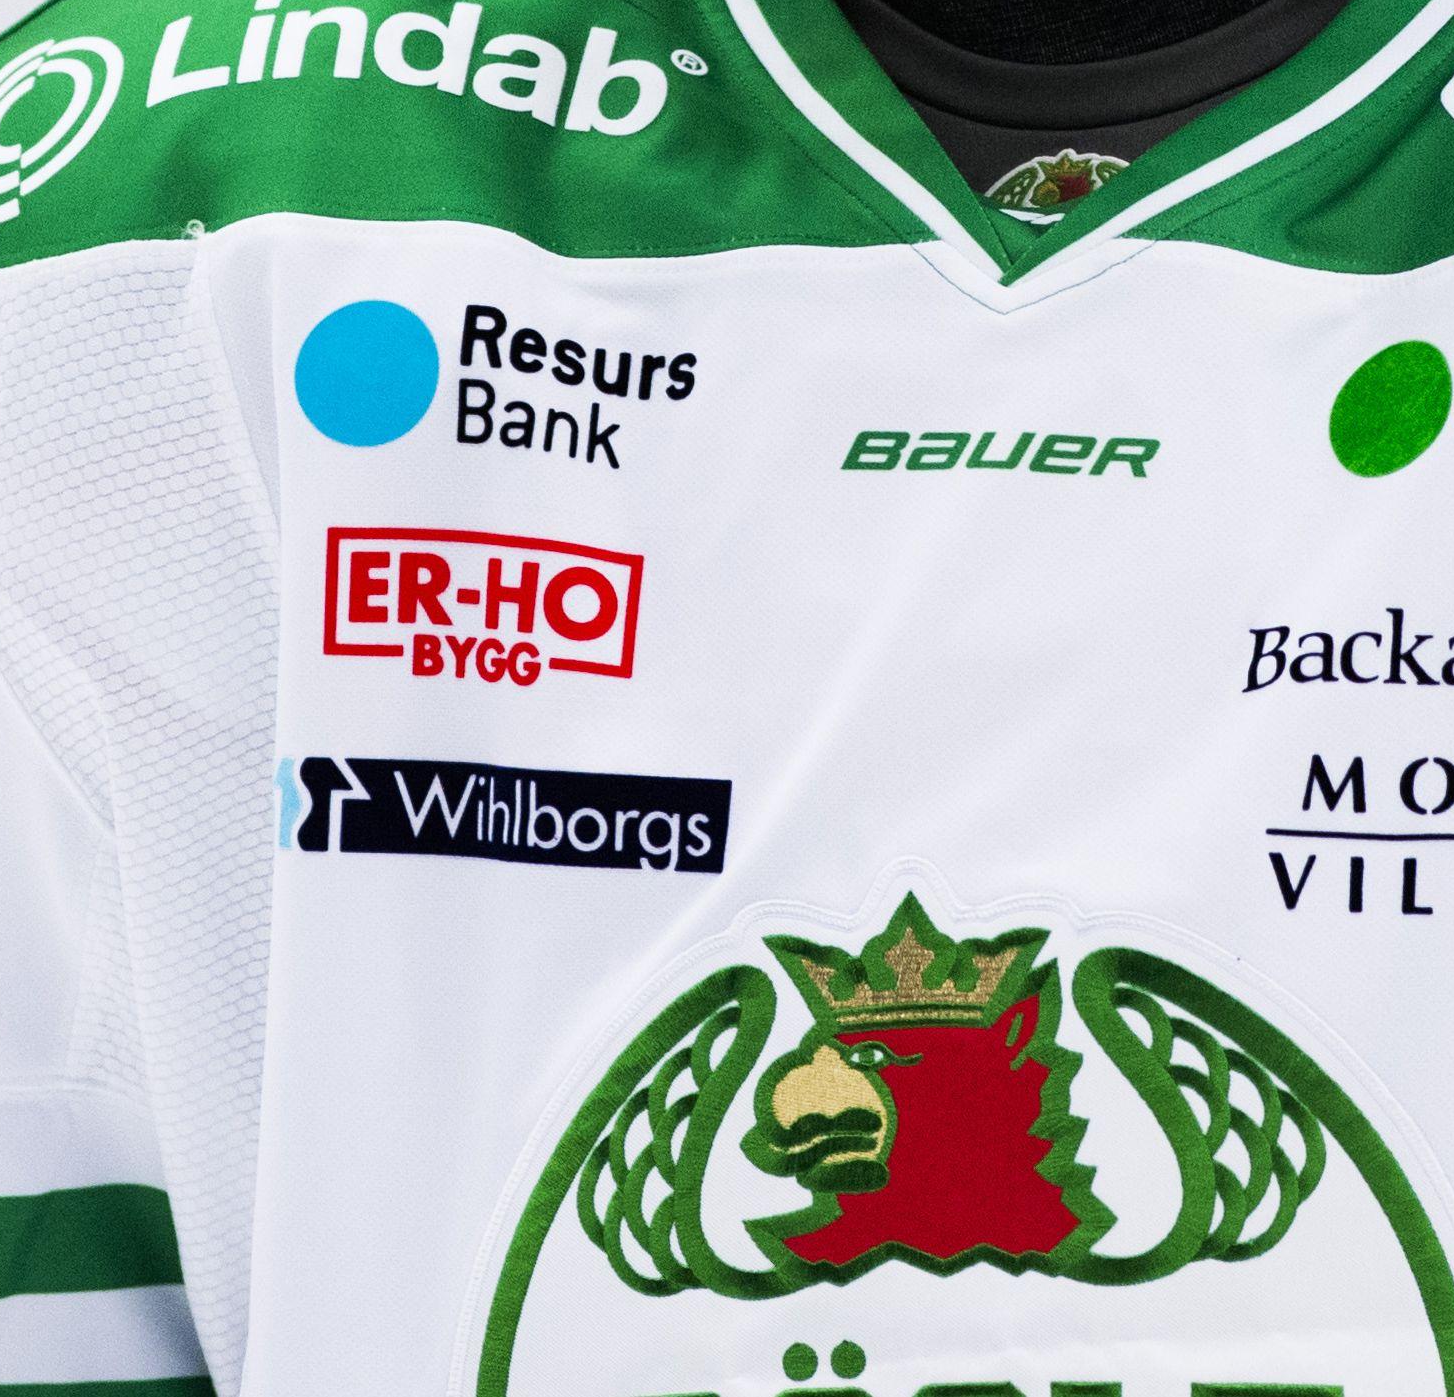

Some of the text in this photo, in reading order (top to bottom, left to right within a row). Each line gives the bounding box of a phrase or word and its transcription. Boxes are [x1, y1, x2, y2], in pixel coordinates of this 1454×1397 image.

[458, 304, 698, 402] Resurs
[456, 377, 621, 470] Bank
[347, 550, 619, 642] ER-HO
[411, 633, 542, 687] BYGG
[393, 769, 713, 871] Wihlborgs
